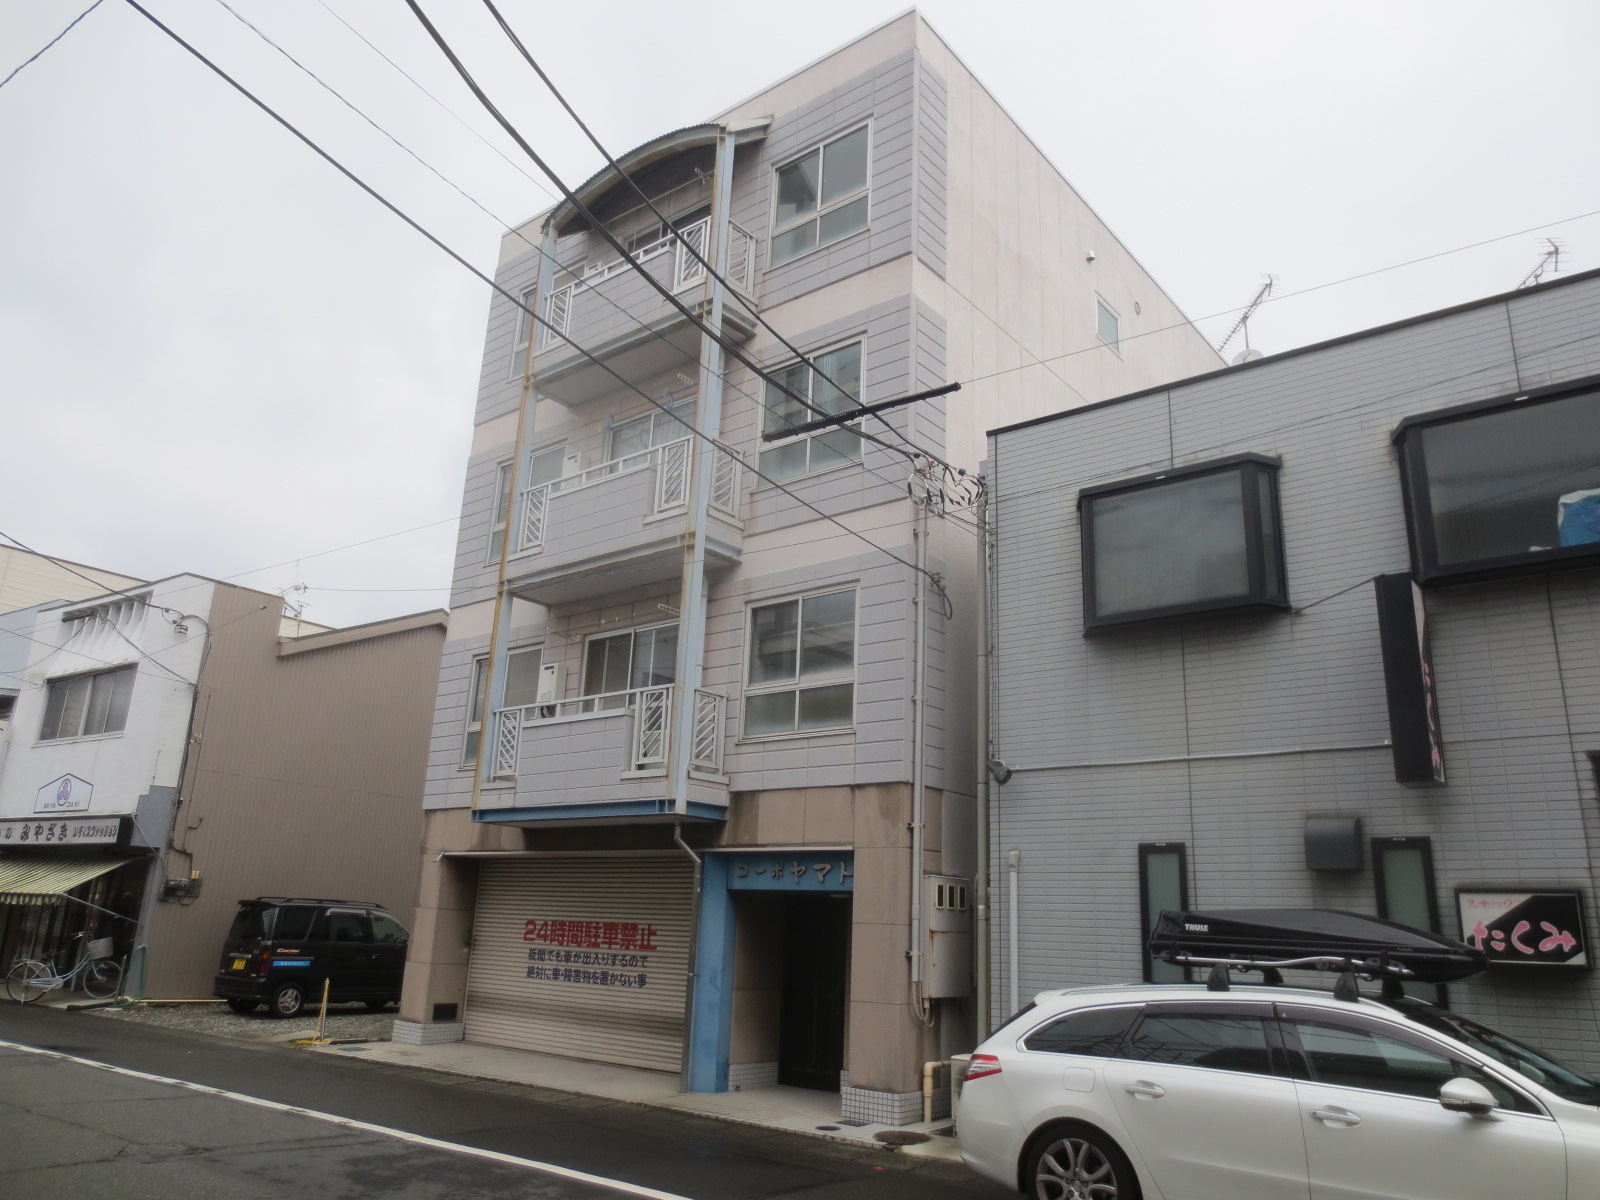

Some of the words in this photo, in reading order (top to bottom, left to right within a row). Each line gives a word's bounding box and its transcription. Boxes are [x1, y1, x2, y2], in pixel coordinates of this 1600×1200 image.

[20, 822, 68, 841] みやざき
[736, 860, 854, 884] コーポヤマト
[523, 919, 658, 950] 24時間駐車禁止
[1184, 923, 1209, 931] THULE
[1472, 920, 1577, 955] たくみ
[528, 948, 649, 969] 夜間でも車が出入りするので
